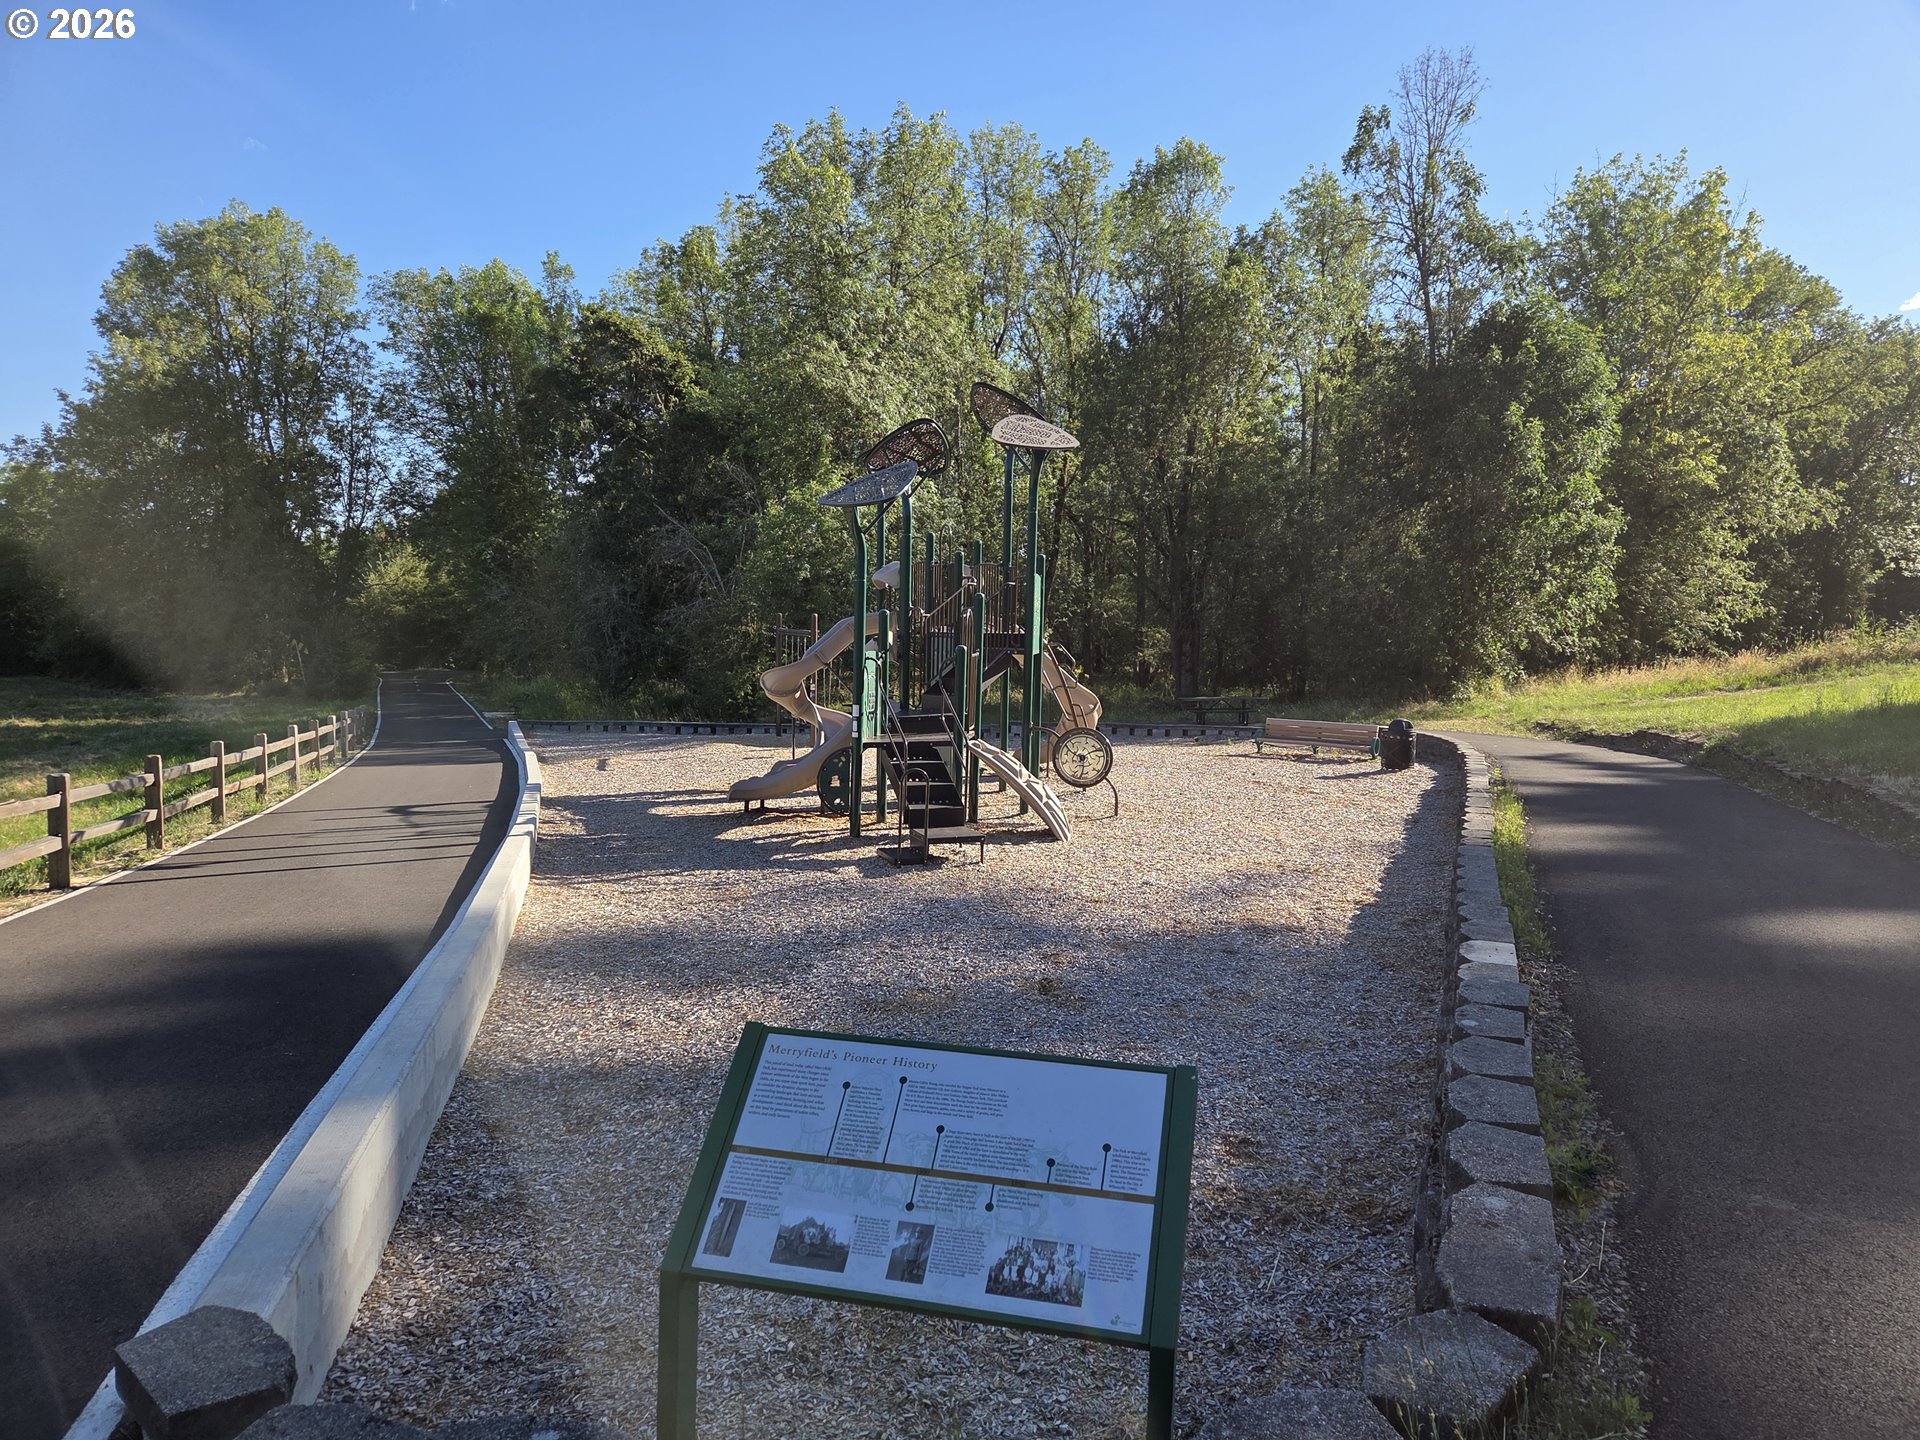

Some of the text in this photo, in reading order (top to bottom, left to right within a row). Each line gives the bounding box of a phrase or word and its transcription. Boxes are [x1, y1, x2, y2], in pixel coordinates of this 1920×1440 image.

[768, 1044, 938, 1072] Merryfield's Pioneer History
